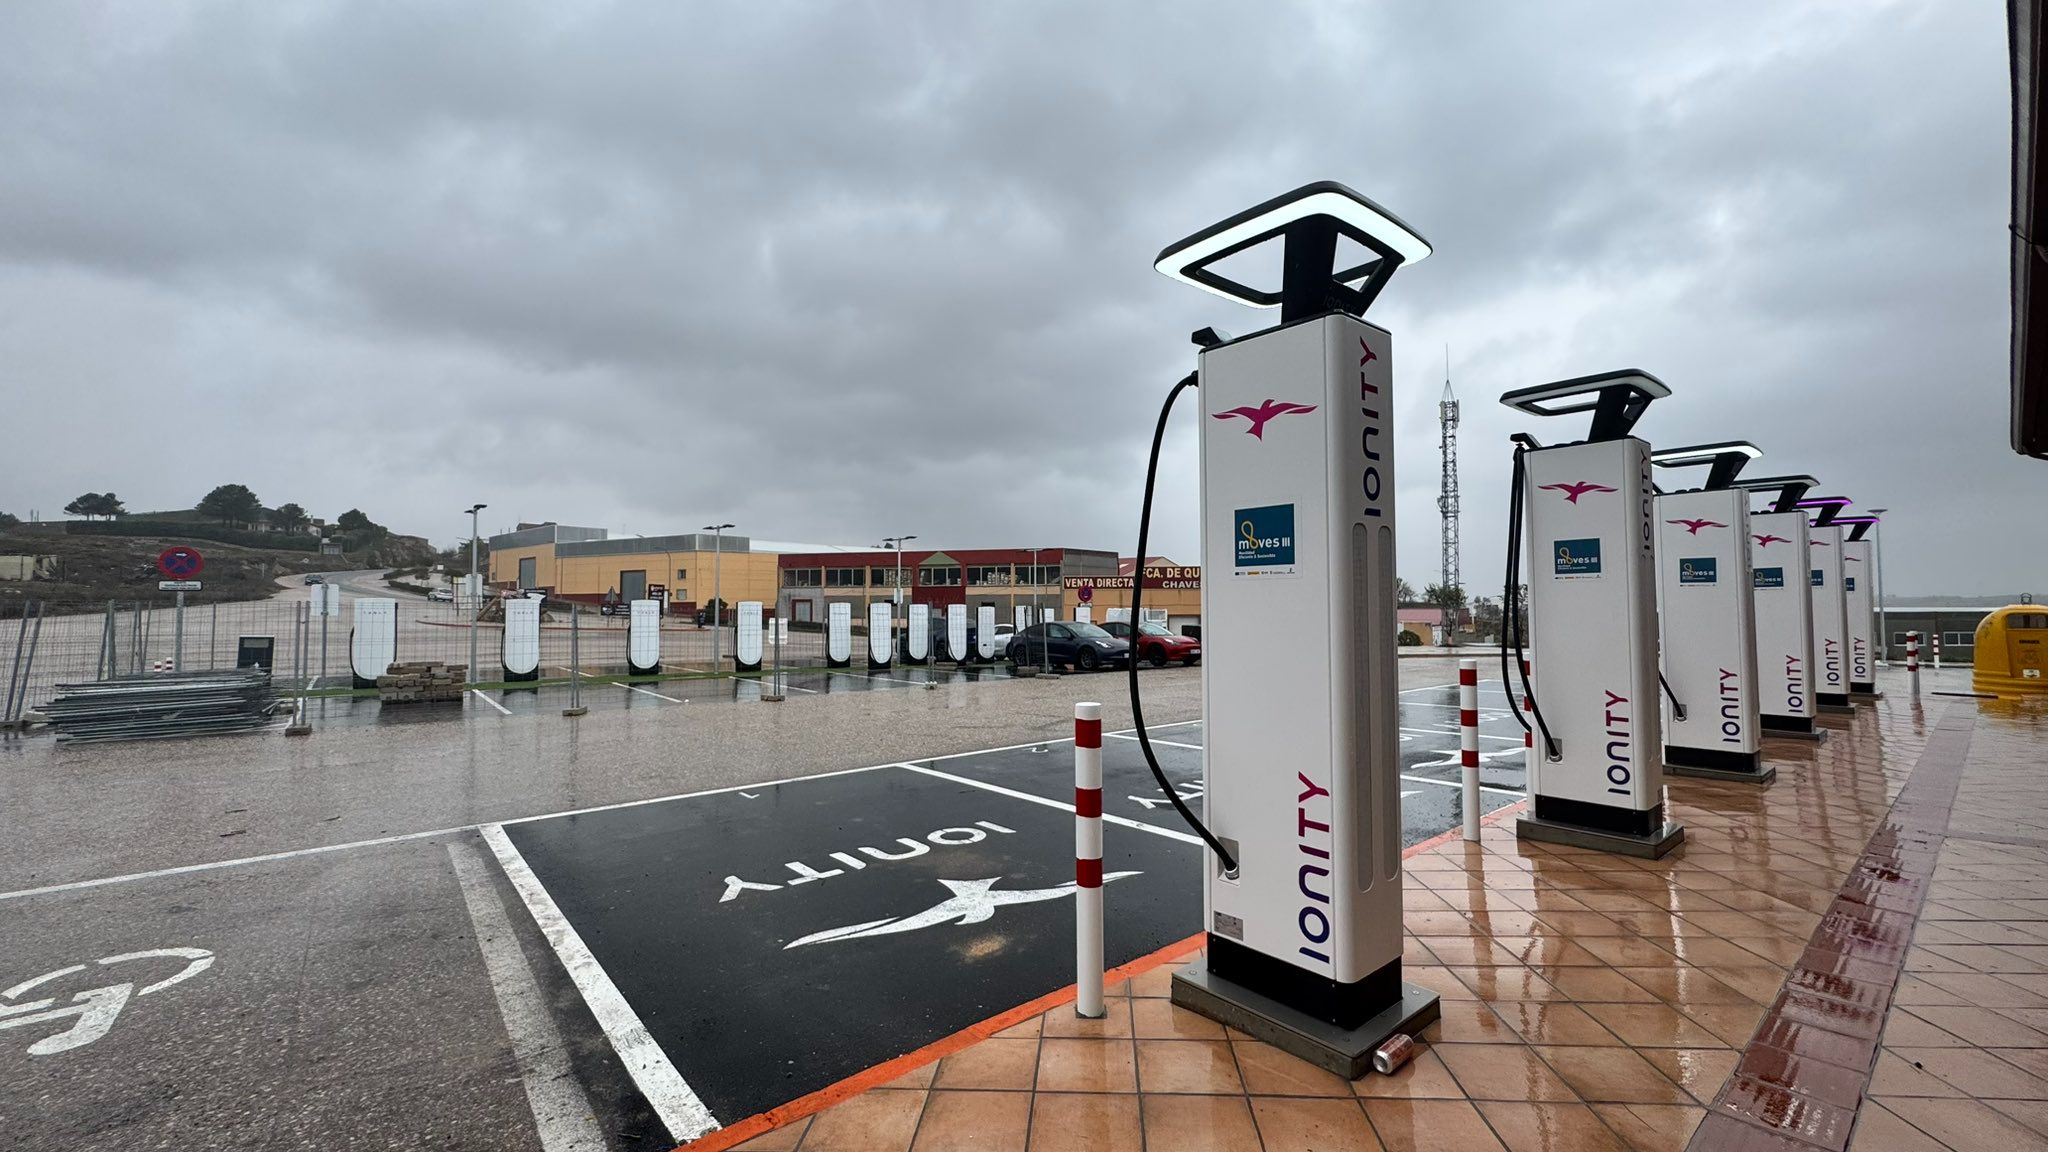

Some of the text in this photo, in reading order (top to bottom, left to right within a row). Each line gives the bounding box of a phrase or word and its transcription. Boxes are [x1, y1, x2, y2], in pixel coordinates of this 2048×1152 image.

[1360, 336, 1381, 517] IONITY
[1065, 578, 1134, 588] VENTA DIRECTA
[1162, 580, 1201, 589] CHAVE
[1166, 567, 1183, 578] DE
[1184, 567, 1200, 578] QU
[1786, 654, 1803, 713] IONITY
[1825, 638, 1840, 686] IONITY
[1854, 637, 1866, 678] IONITY
[1719, 667, 1741, 743] IONITY
[1605, 689, 1631, 795] IONITY
[718, 820, 1017, 903] IONITY
[1299, 771, 1330, 964] IONITY
